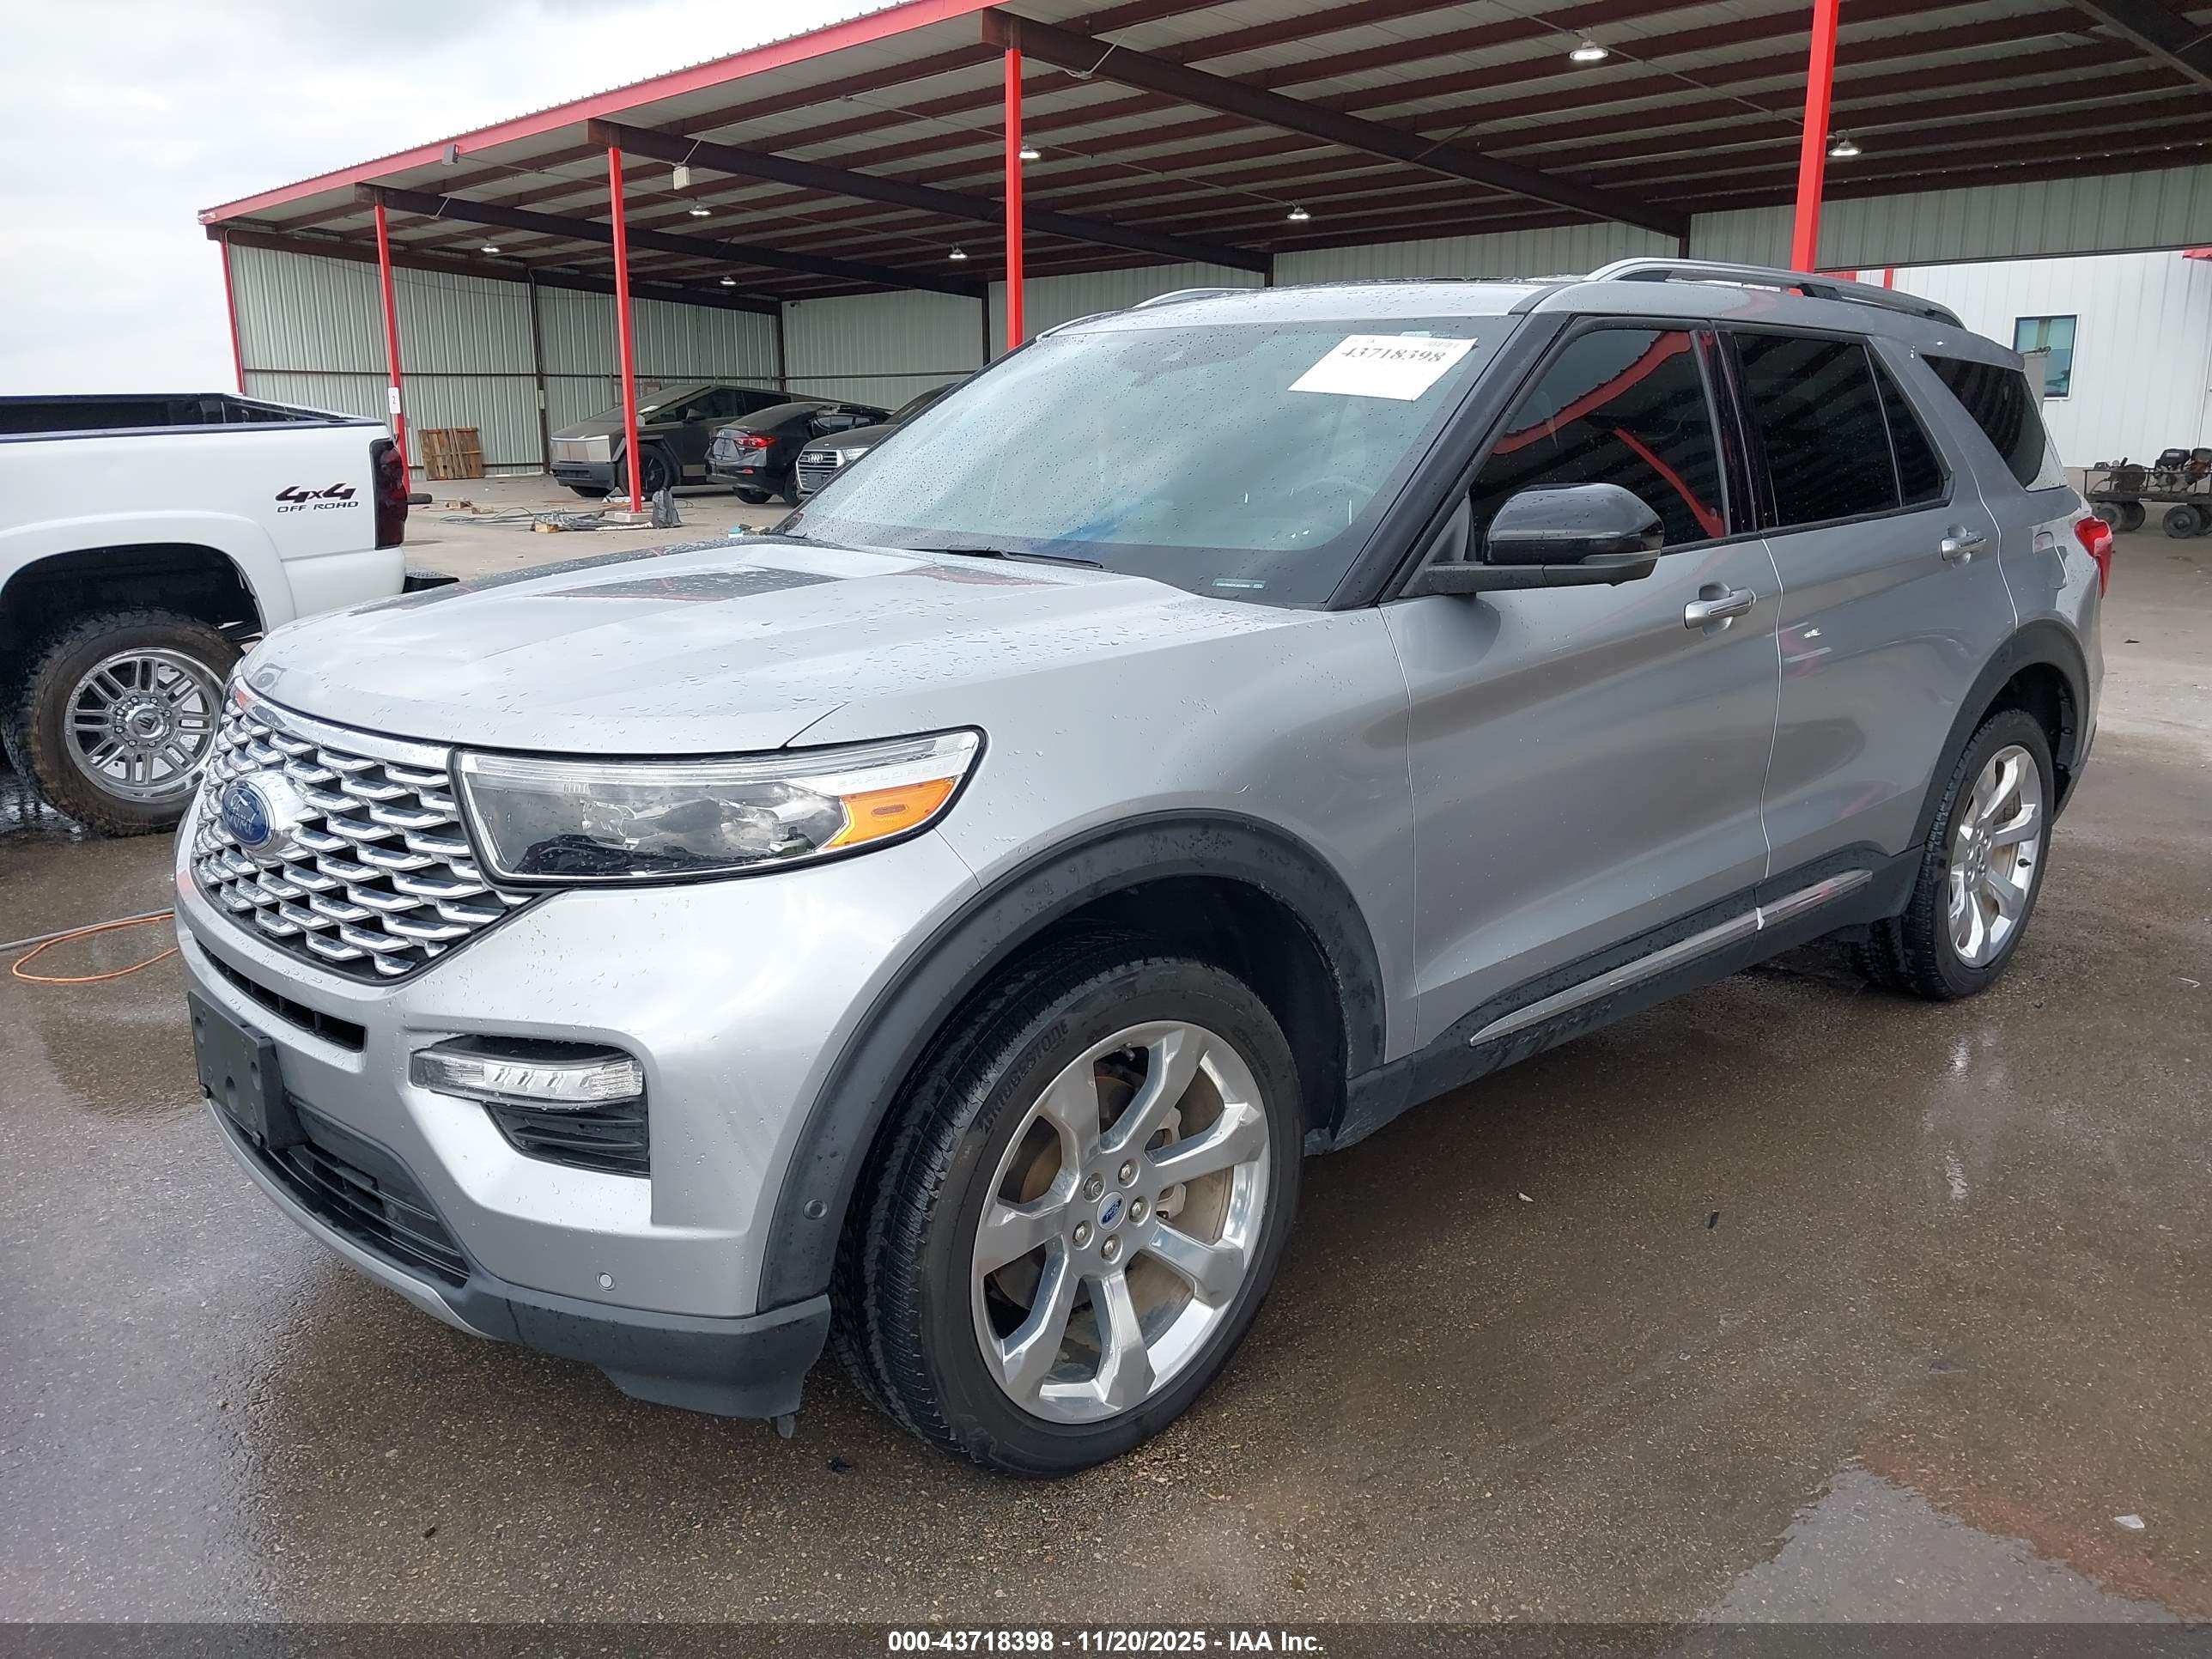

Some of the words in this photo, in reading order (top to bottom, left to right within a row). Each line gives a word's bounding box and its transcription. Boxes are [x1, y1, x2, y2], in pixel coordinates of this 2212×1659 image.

[1341, 347, 1447, 362] 43718398
[275, 483, 357, 503] 4x4
[313, 501, 359, 510] ROAD
